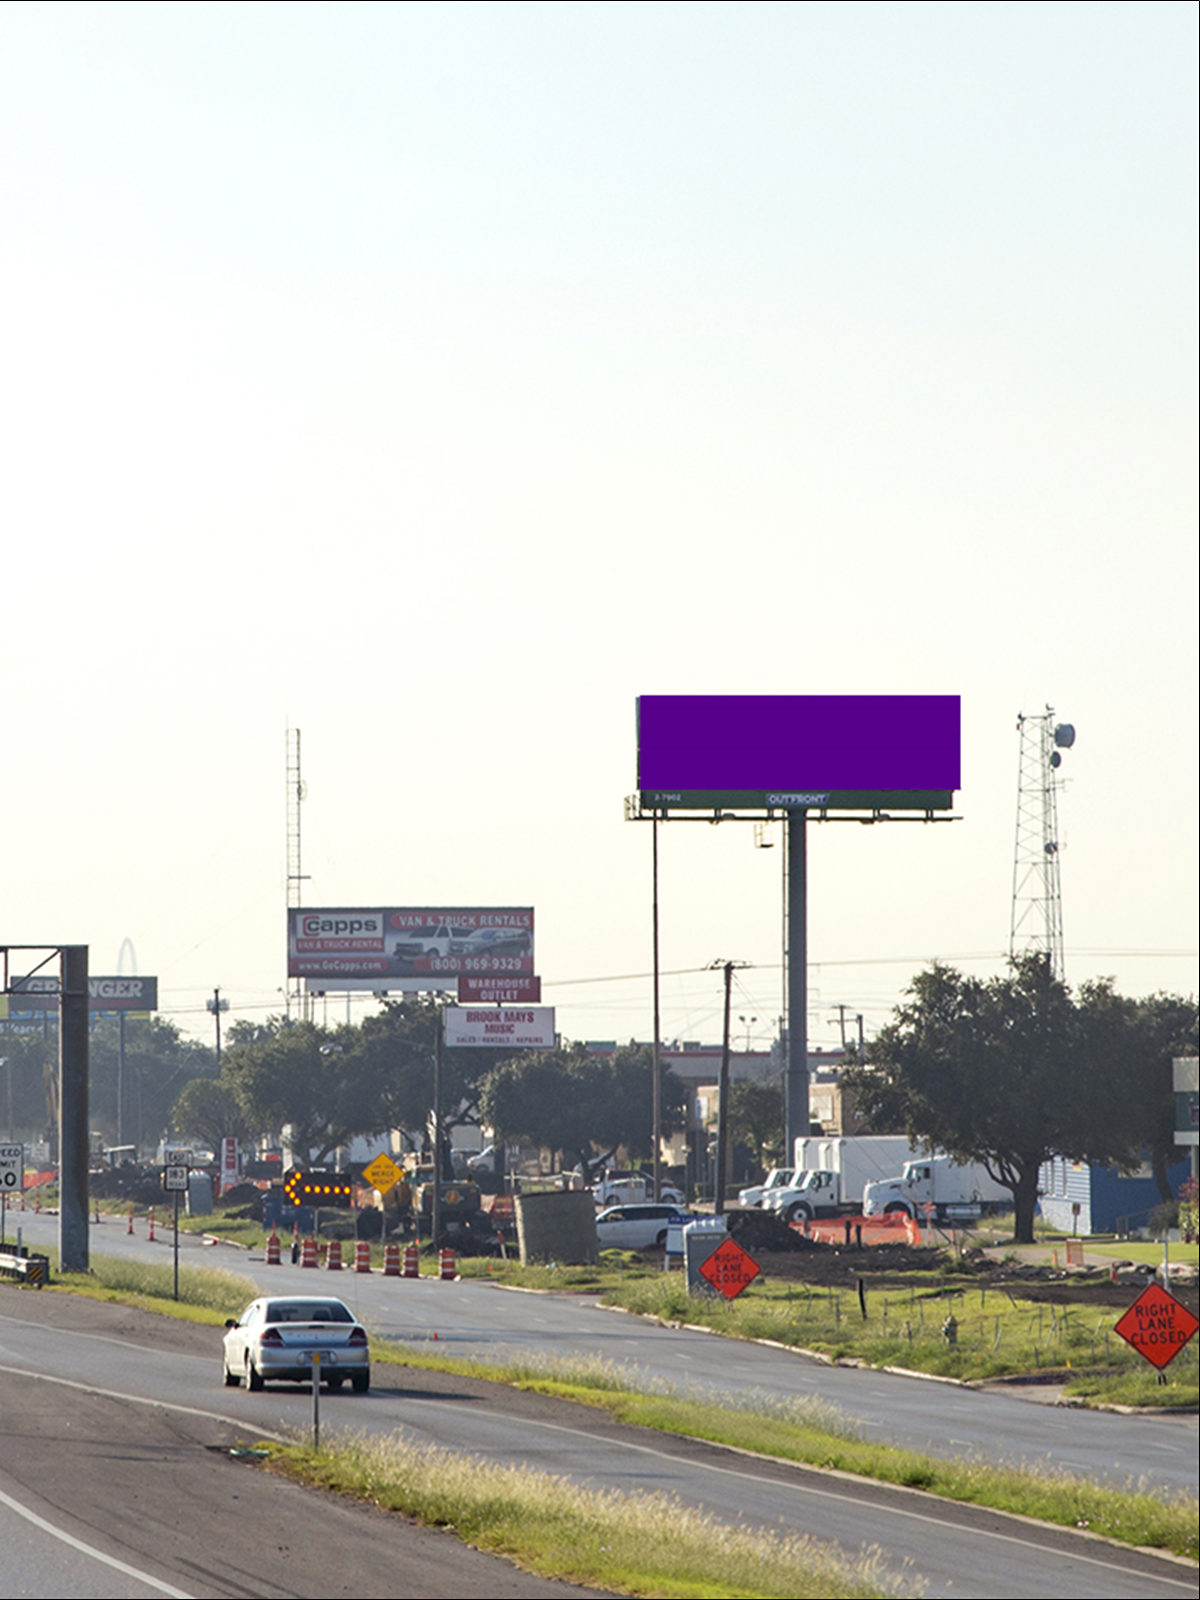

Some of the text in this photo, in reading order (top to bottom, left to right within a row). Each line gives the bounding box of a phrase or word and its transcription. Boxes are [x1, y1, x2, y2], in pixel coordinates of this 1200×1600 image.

[767, 793, 828, 804] OUTFRONT
[400, 914, 530, 927] VAN & TRUCK RENTALS
[430, 957, 522, 971] (800) 969-9329
[26, 979, 144, 998] GRNGER
[467, 978, 531, 989] WAREHOUSE
[480, 990, 519, 1001] OUTLET
[466, 1011, 535, 1023] BROOK MAYS
[484, 1024, 515, 1034] MUSIC
[482, 1036, 510, 1044] RENTALS
[516, 1036, 544, 1044] REPAIRS
[371, 1170, 395, 1178] MERGE
[714, 1253, 744, 1263] RIGHT
[715, 1263, 743, 1273] LANE
[709, 1273, 751, 1284] CLOSED
[1135, 1303, 1177, 1318] RIGHT
[1138, 1317, 1177, 1331] LANE
[1130, 1330, 1187, 1346] CLOSED
